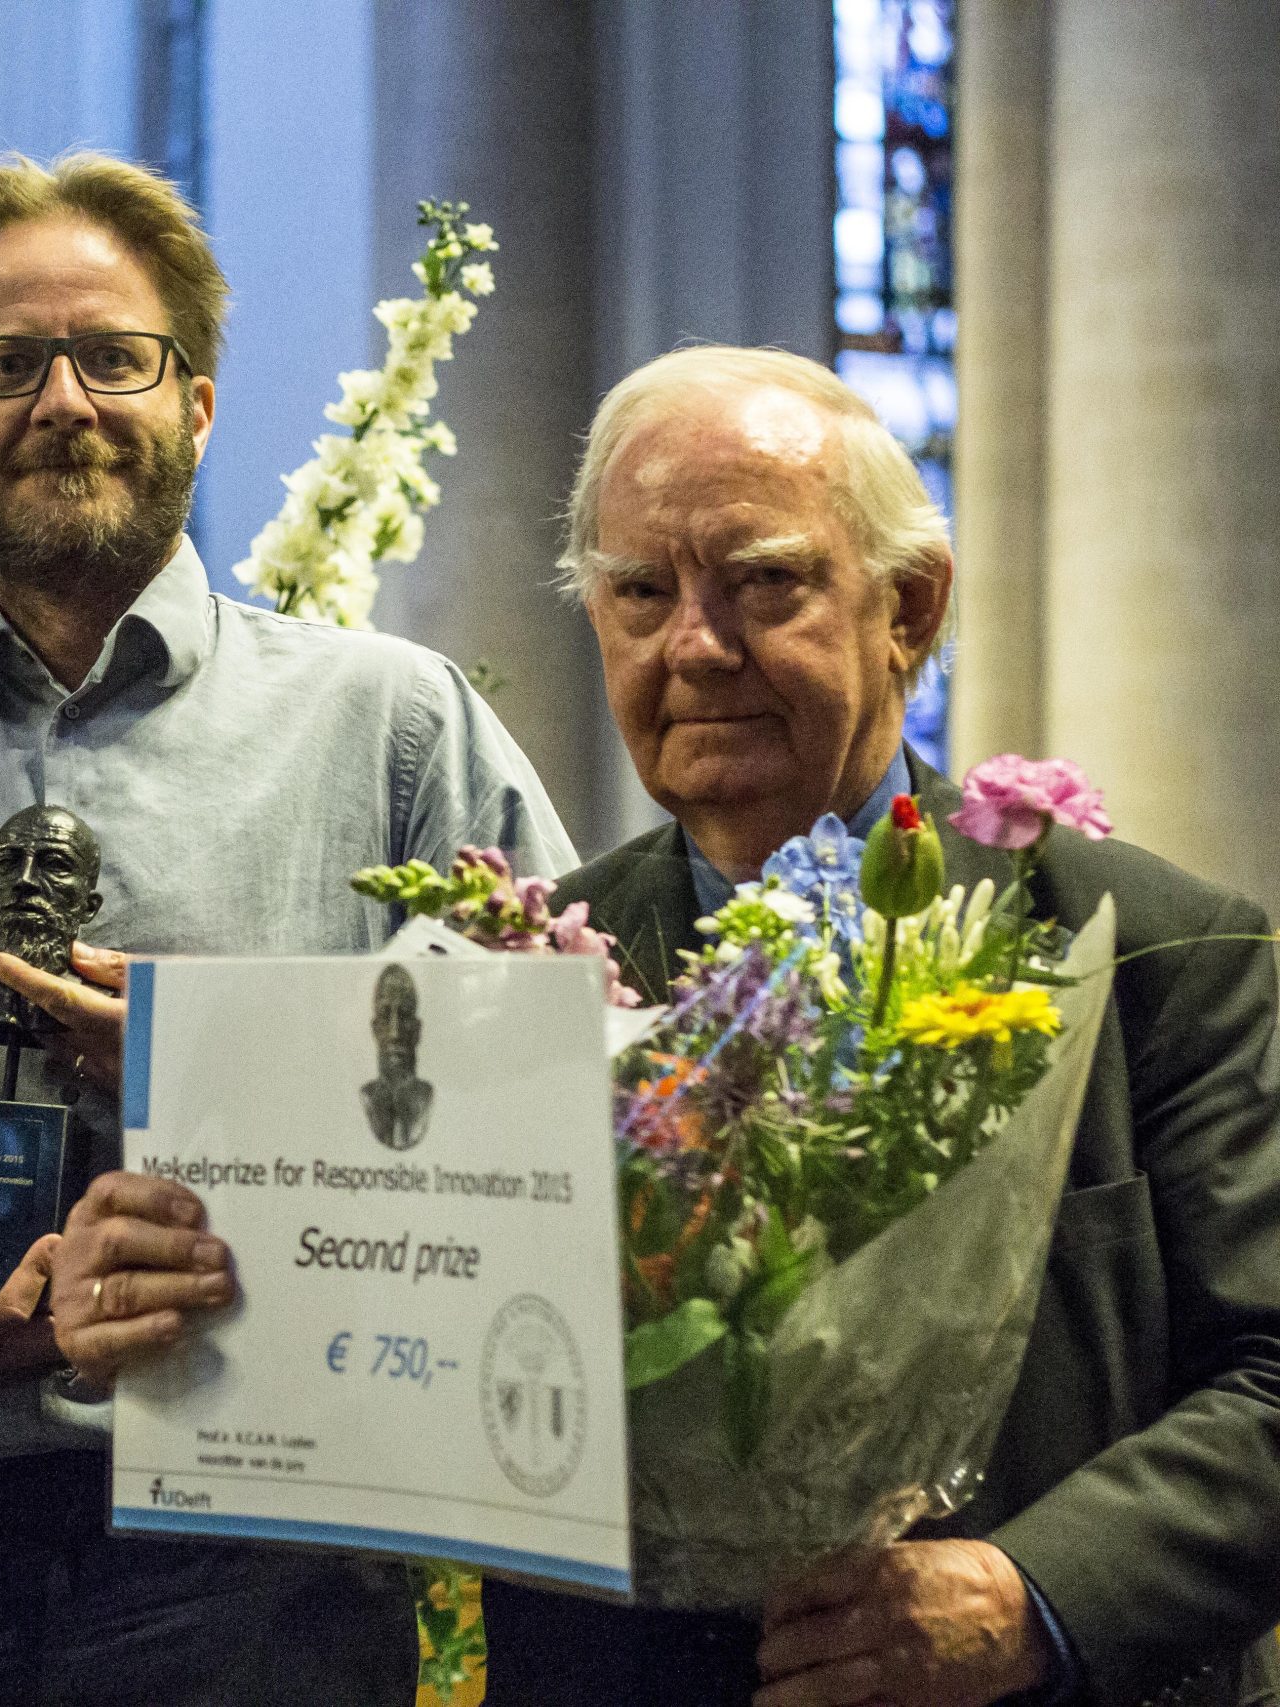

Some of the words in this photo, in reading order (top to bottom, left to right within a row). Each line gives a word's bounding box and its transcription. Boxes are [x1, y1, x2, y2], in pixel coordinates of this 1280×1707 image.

[274, 1156, 305, 1187] for
[312, 1158, 428, 1194] Responsible
[294, 1226, 410, 1273] Second
[413, 1235, 481, 1284] prize
